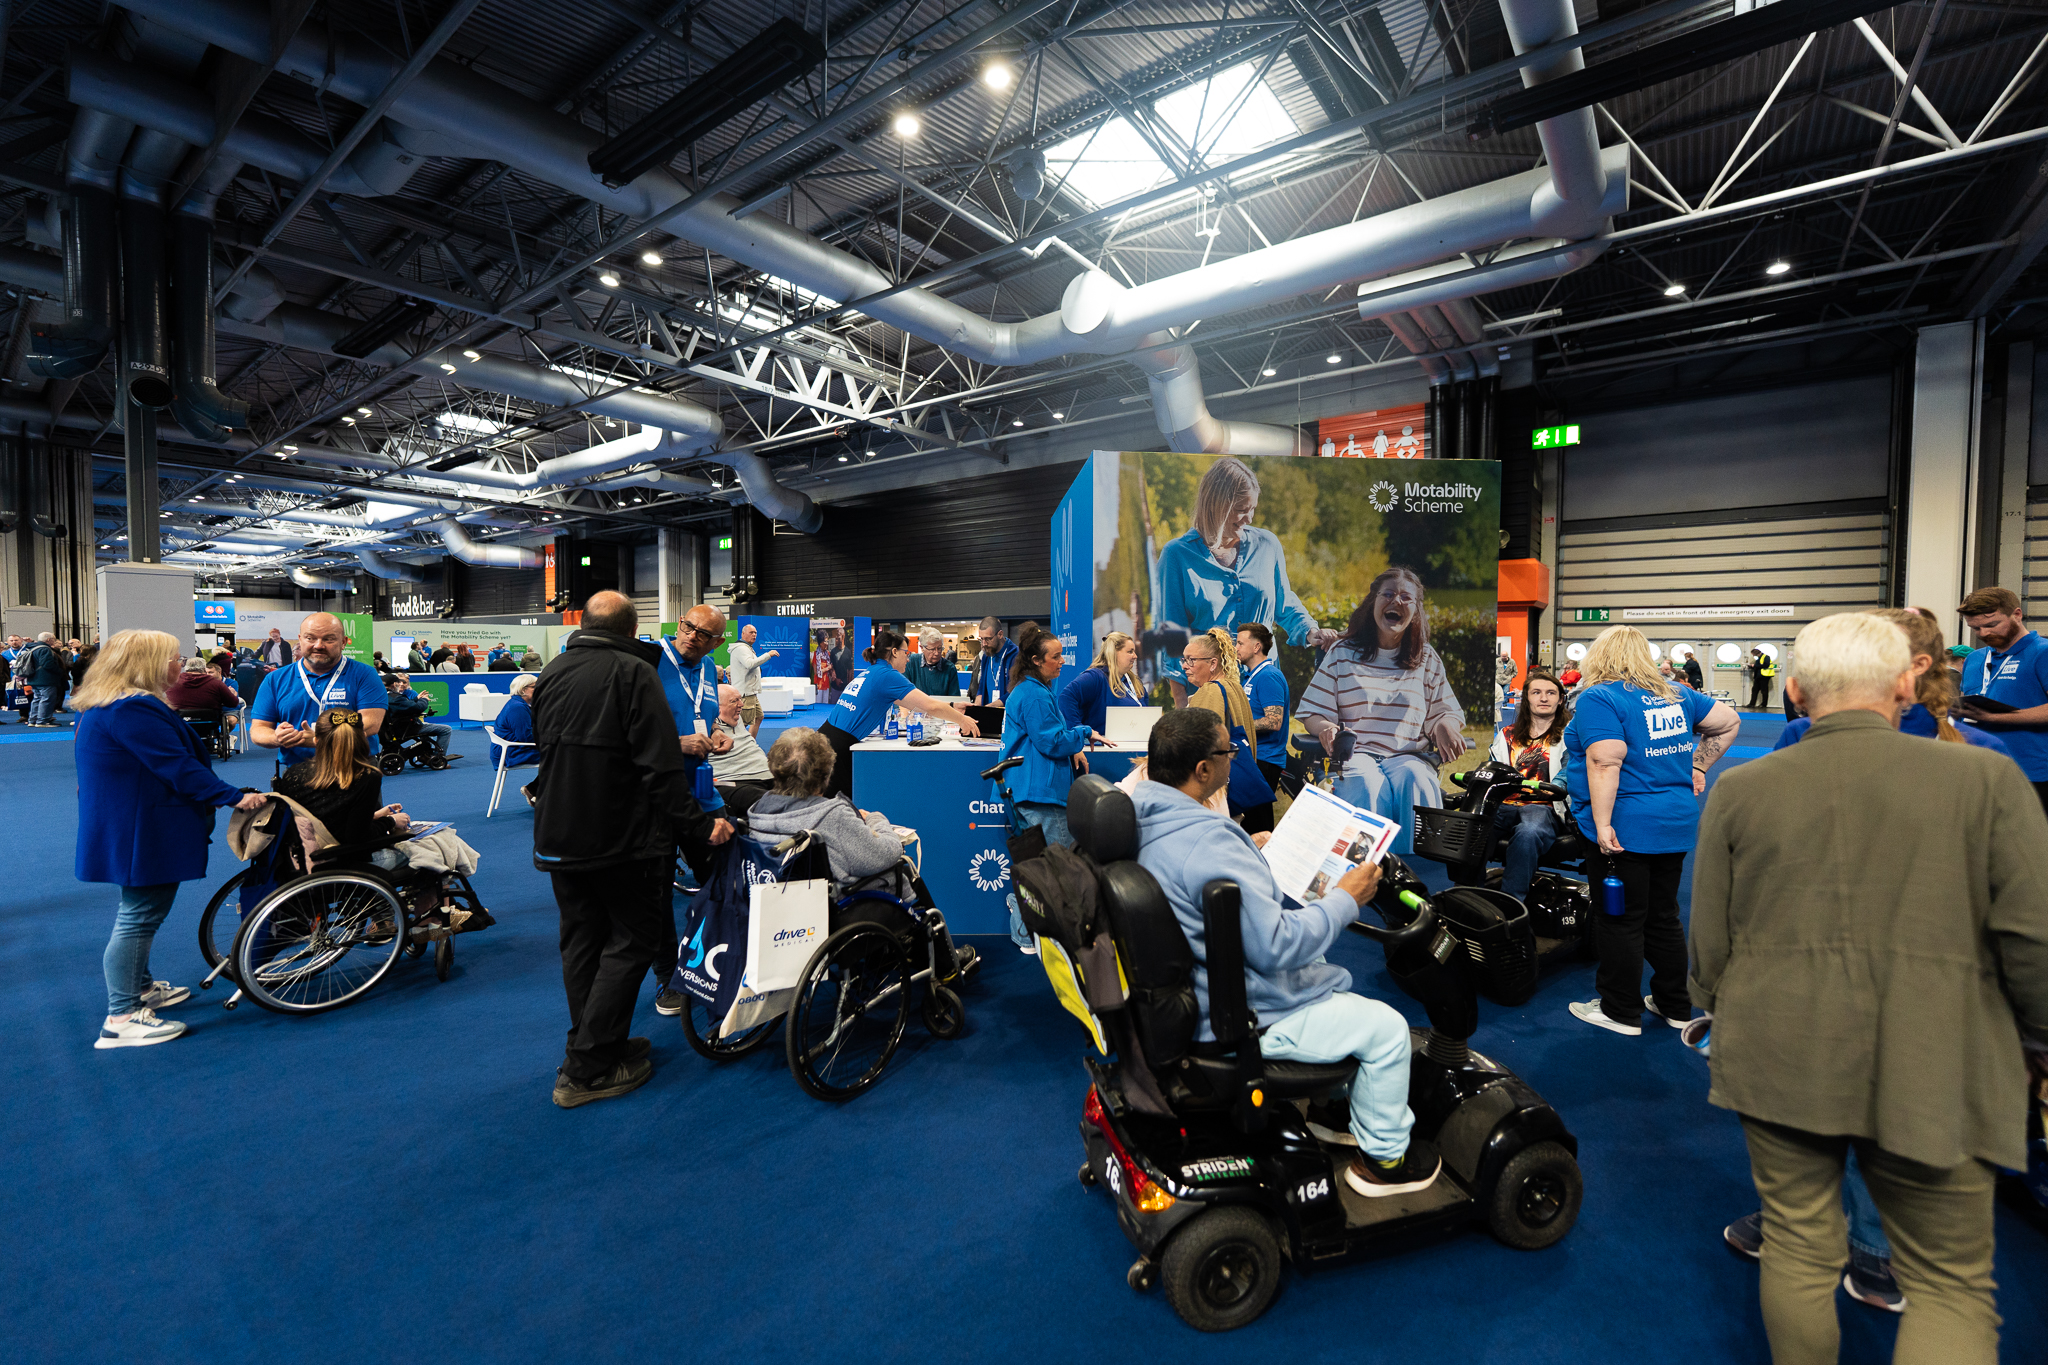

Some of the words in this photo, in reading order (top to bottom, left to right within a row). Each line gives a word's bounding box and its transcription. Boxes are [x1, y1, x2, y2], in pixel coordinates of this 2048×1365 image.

[1404, 482, 1482, 502] Motability
[1404, 497, 1464, 513] Scheme
[777, 604, 815, 616] ENTRANCE
[1652, 713, 1684, 733] Live
[1645, 747, 1669, 758] Here
[1668, 745, 1678, 755] to
[1678, 741, 1694, 753] help
[1475, 770, 1494, 780] 139
[968, 800, 1005, 814] Chat
[1561, 915, 1576, 926] 139
[773, 928, 807, 942] drive
[738, 993, 765, 1005] 0800
[1197, 1169, 1252, 1182] BATTERIES
[1297, 1177, 1329, 1203] 164
